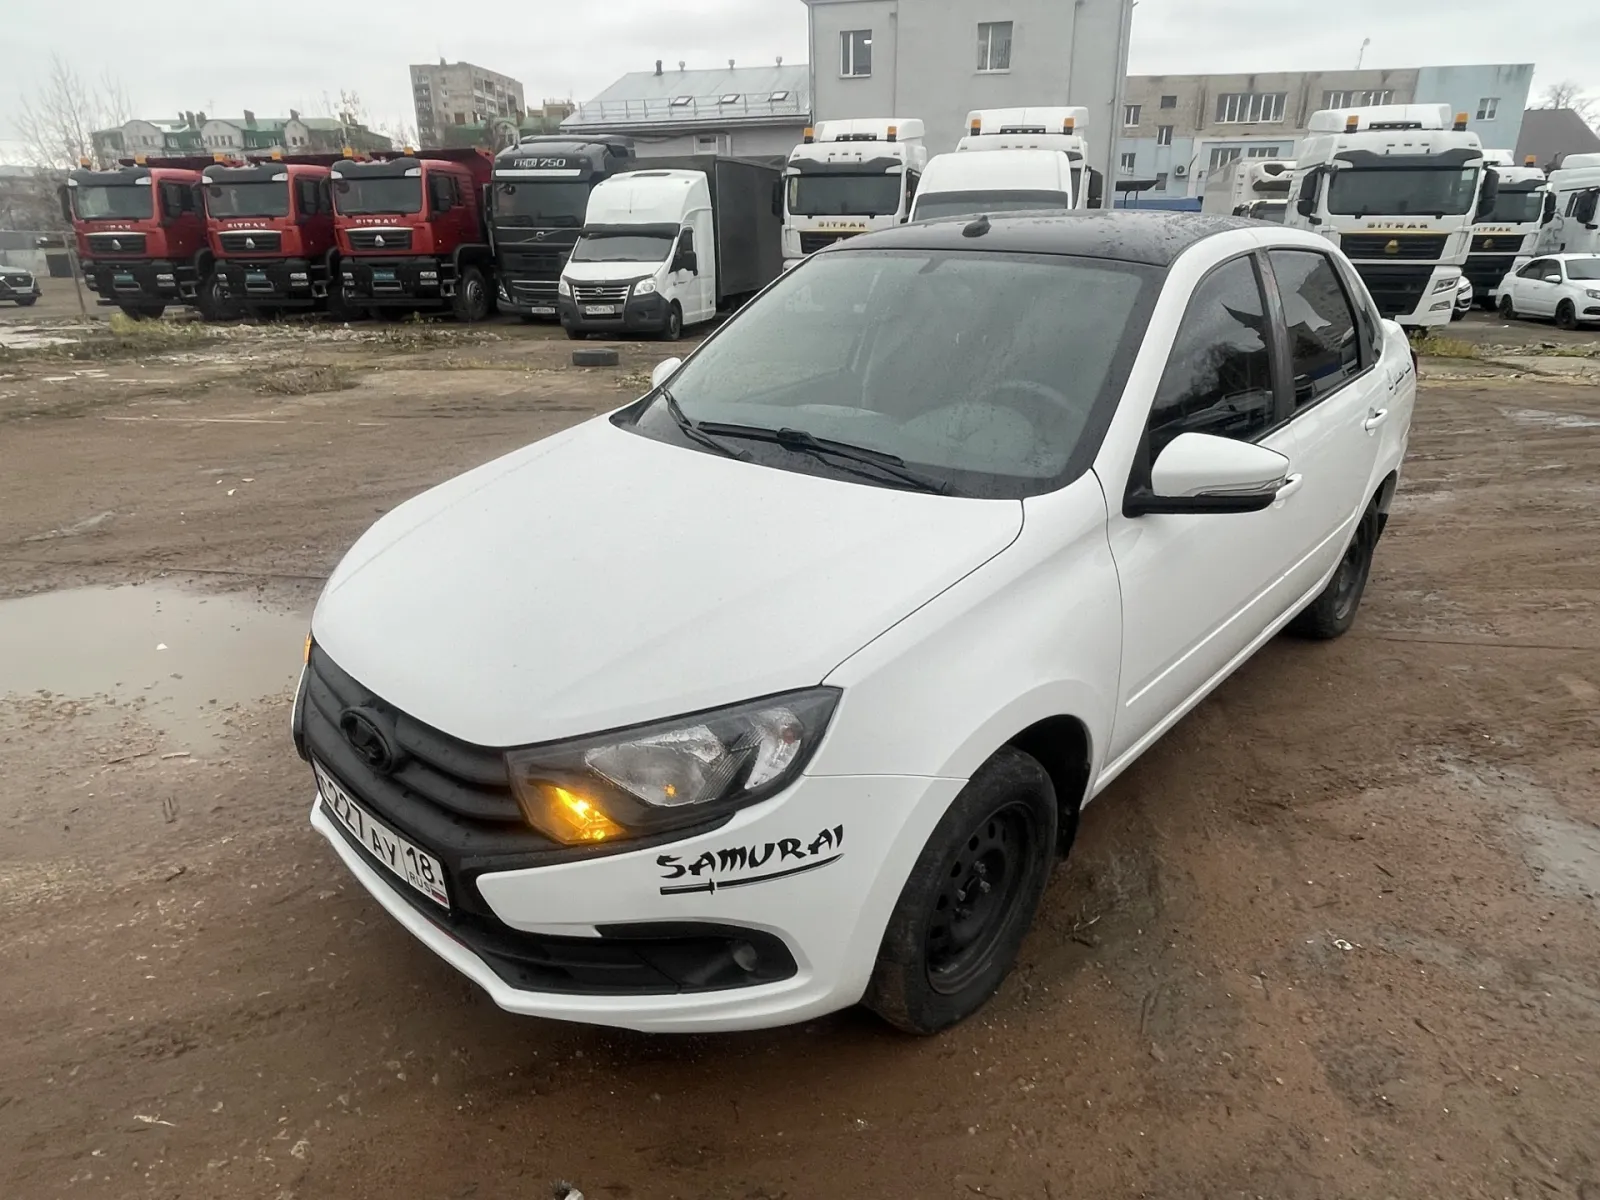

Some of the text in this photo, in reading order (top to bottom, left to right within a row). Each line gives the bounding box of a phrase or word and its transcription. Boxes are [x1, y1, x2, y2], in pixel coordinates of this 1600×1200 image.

[539, 157, 566, 168] 750
[818, 220, 866, 228] SITRAK
[1367, 221, 1429, 229] SITRAK
[656, 824, 844, 879] SAMURAI
[406, 846, 435, 885] 18
[409, 870, 431, 893] RUS
